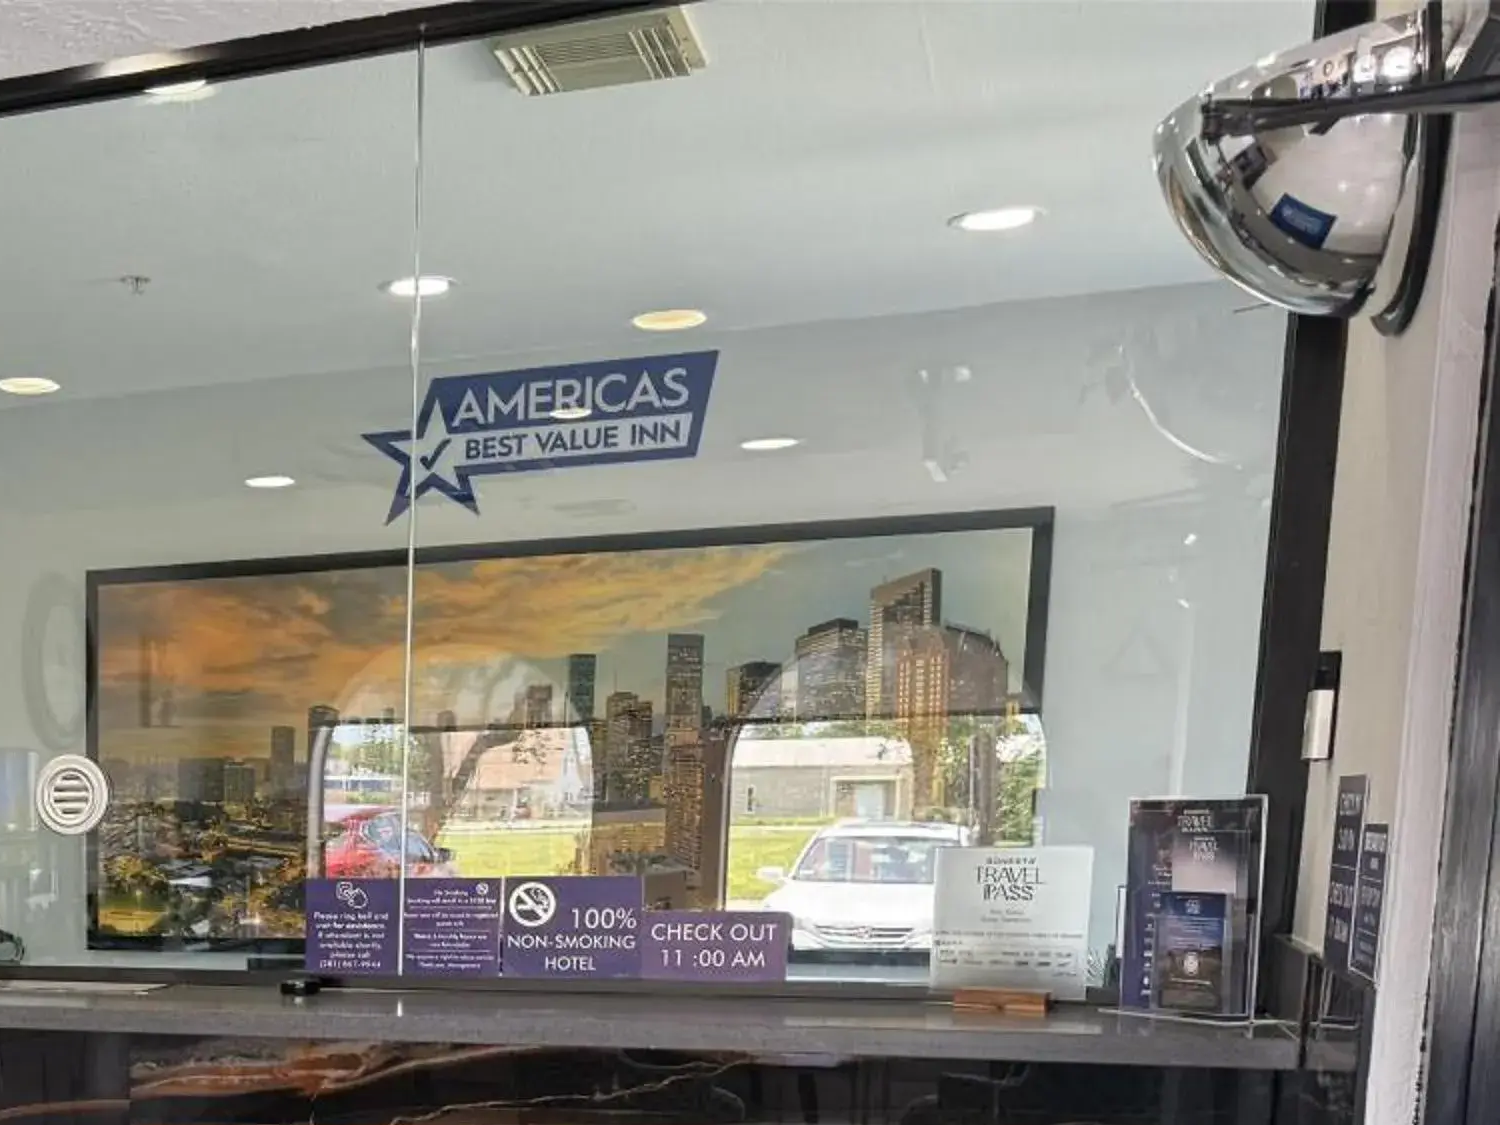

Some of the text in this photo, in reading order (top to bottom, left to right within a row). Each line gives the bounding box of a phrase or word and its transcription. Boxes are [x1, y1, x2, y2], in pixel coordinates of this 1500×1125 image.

[452, 367, 688, 428] AMERICAS
[465, 420, 680, 461] BEST VALUE INN
[976, 866, 1046, 884] TRAVEL
[983, 884, 1033, 901] PASS
[572, 908, 637, 929] 100%
[651, 923, 777, 941] CHECK OUT
[507, 934, 636, 949] NON-SMOKING
[545, 955, 596, 971] HOTEL
[662, 950, 681, 967] 11
[731, 950, 765, 967] AM
